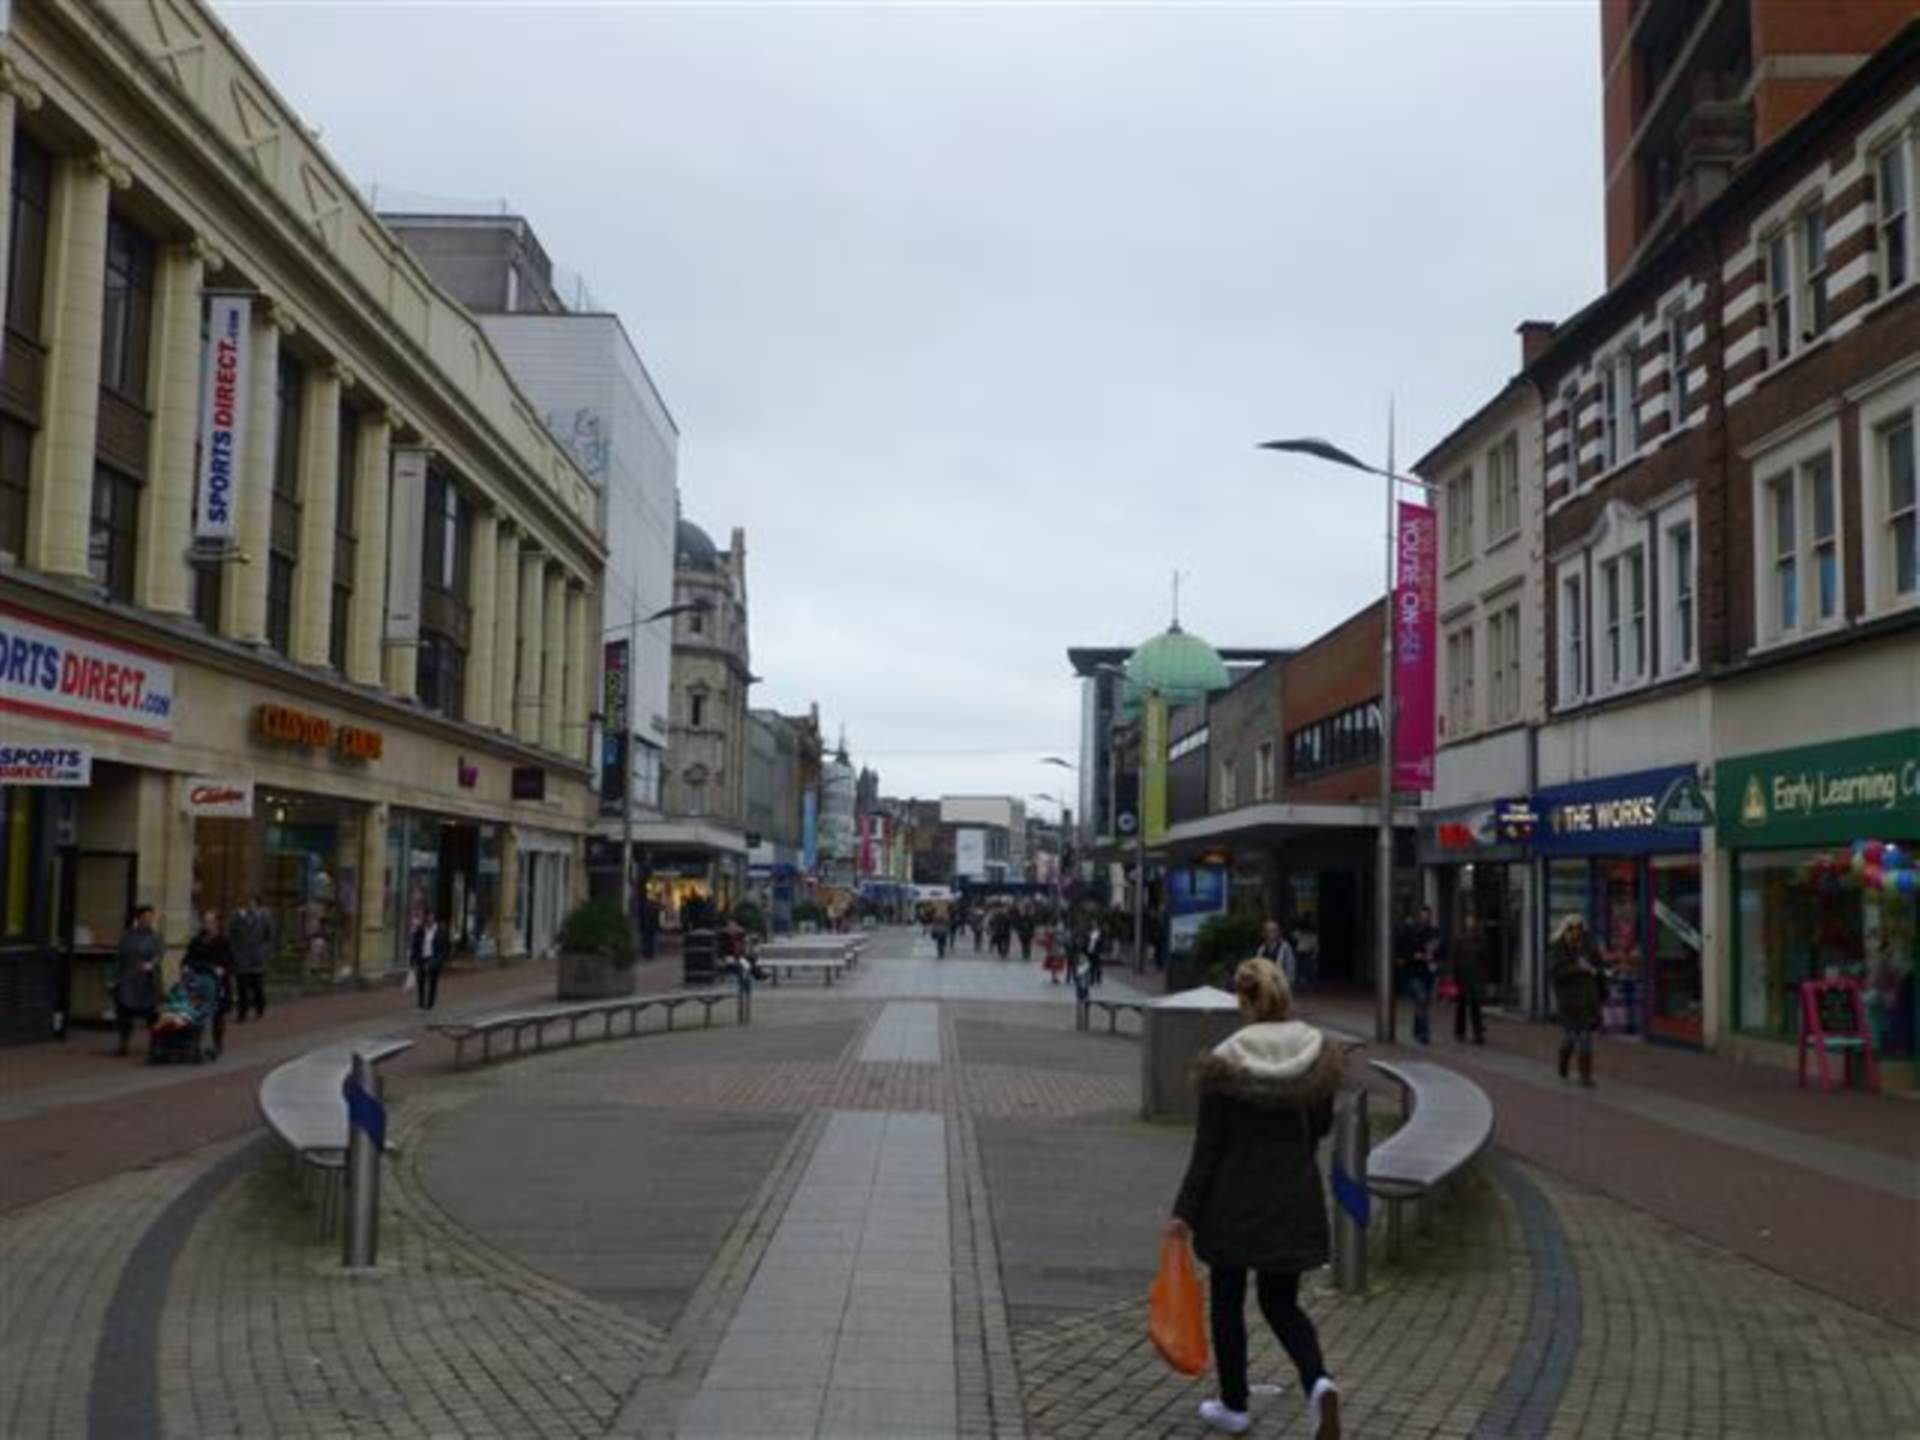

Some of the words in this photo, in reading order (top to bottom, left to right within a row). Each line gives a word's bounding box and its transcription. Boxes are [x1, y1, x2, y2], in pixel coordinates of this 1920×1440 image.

[209, 430, 232, 524] SPORTS
[0, 748, 80, 767] SPORTS
[1774, 771, 1815, 815] Early
[1819, 766, 1897, 809] Learning
[1904, 759, 1920, 797] C
[1564, 804, 1593, 831] THE
[1595, 796, 1657, 829] WORKS
